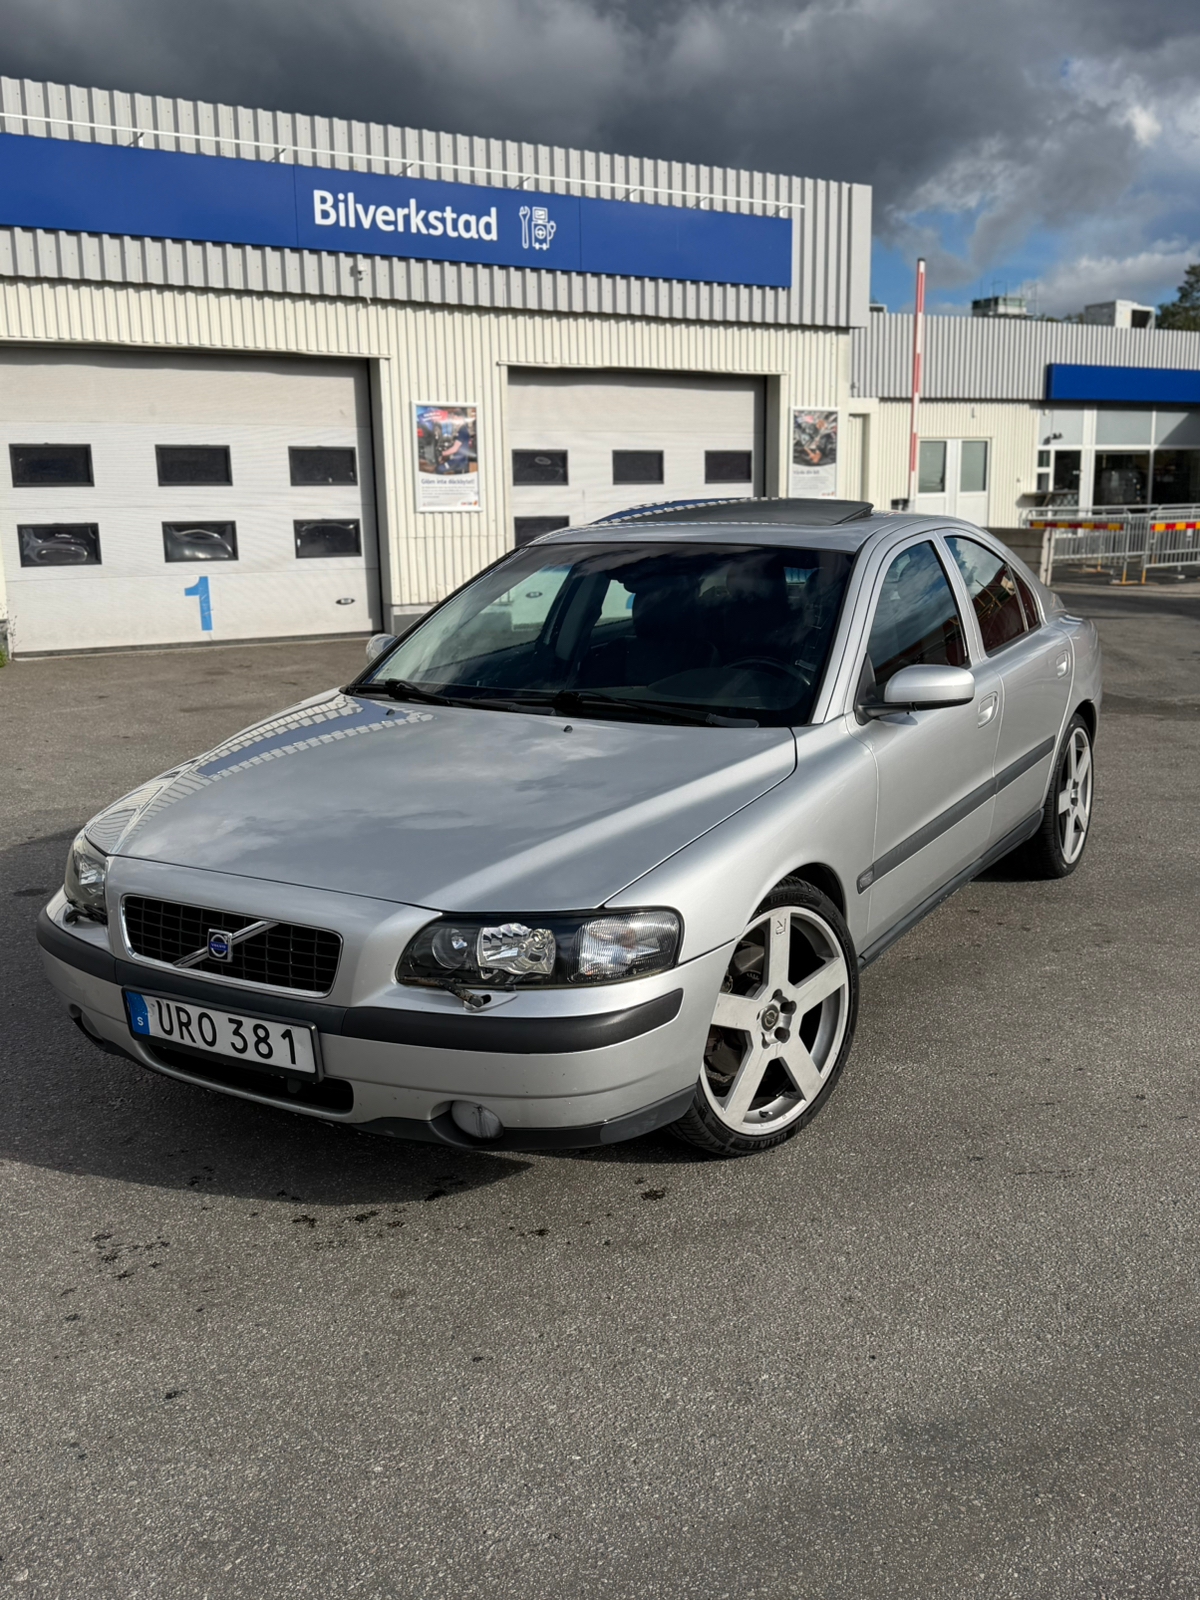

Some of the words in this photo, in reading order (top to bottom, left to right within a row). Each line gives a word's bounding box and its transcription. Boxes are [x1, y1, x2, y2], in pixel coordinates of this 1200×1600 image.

[313, 189, 497, 241] Bilverkstad
[184, 576, 213, 631] 1
[137, 1016, 144, 1026] S
[155, 999, 217, 1047] URO
[228, 1017, 296, 1065] 381
